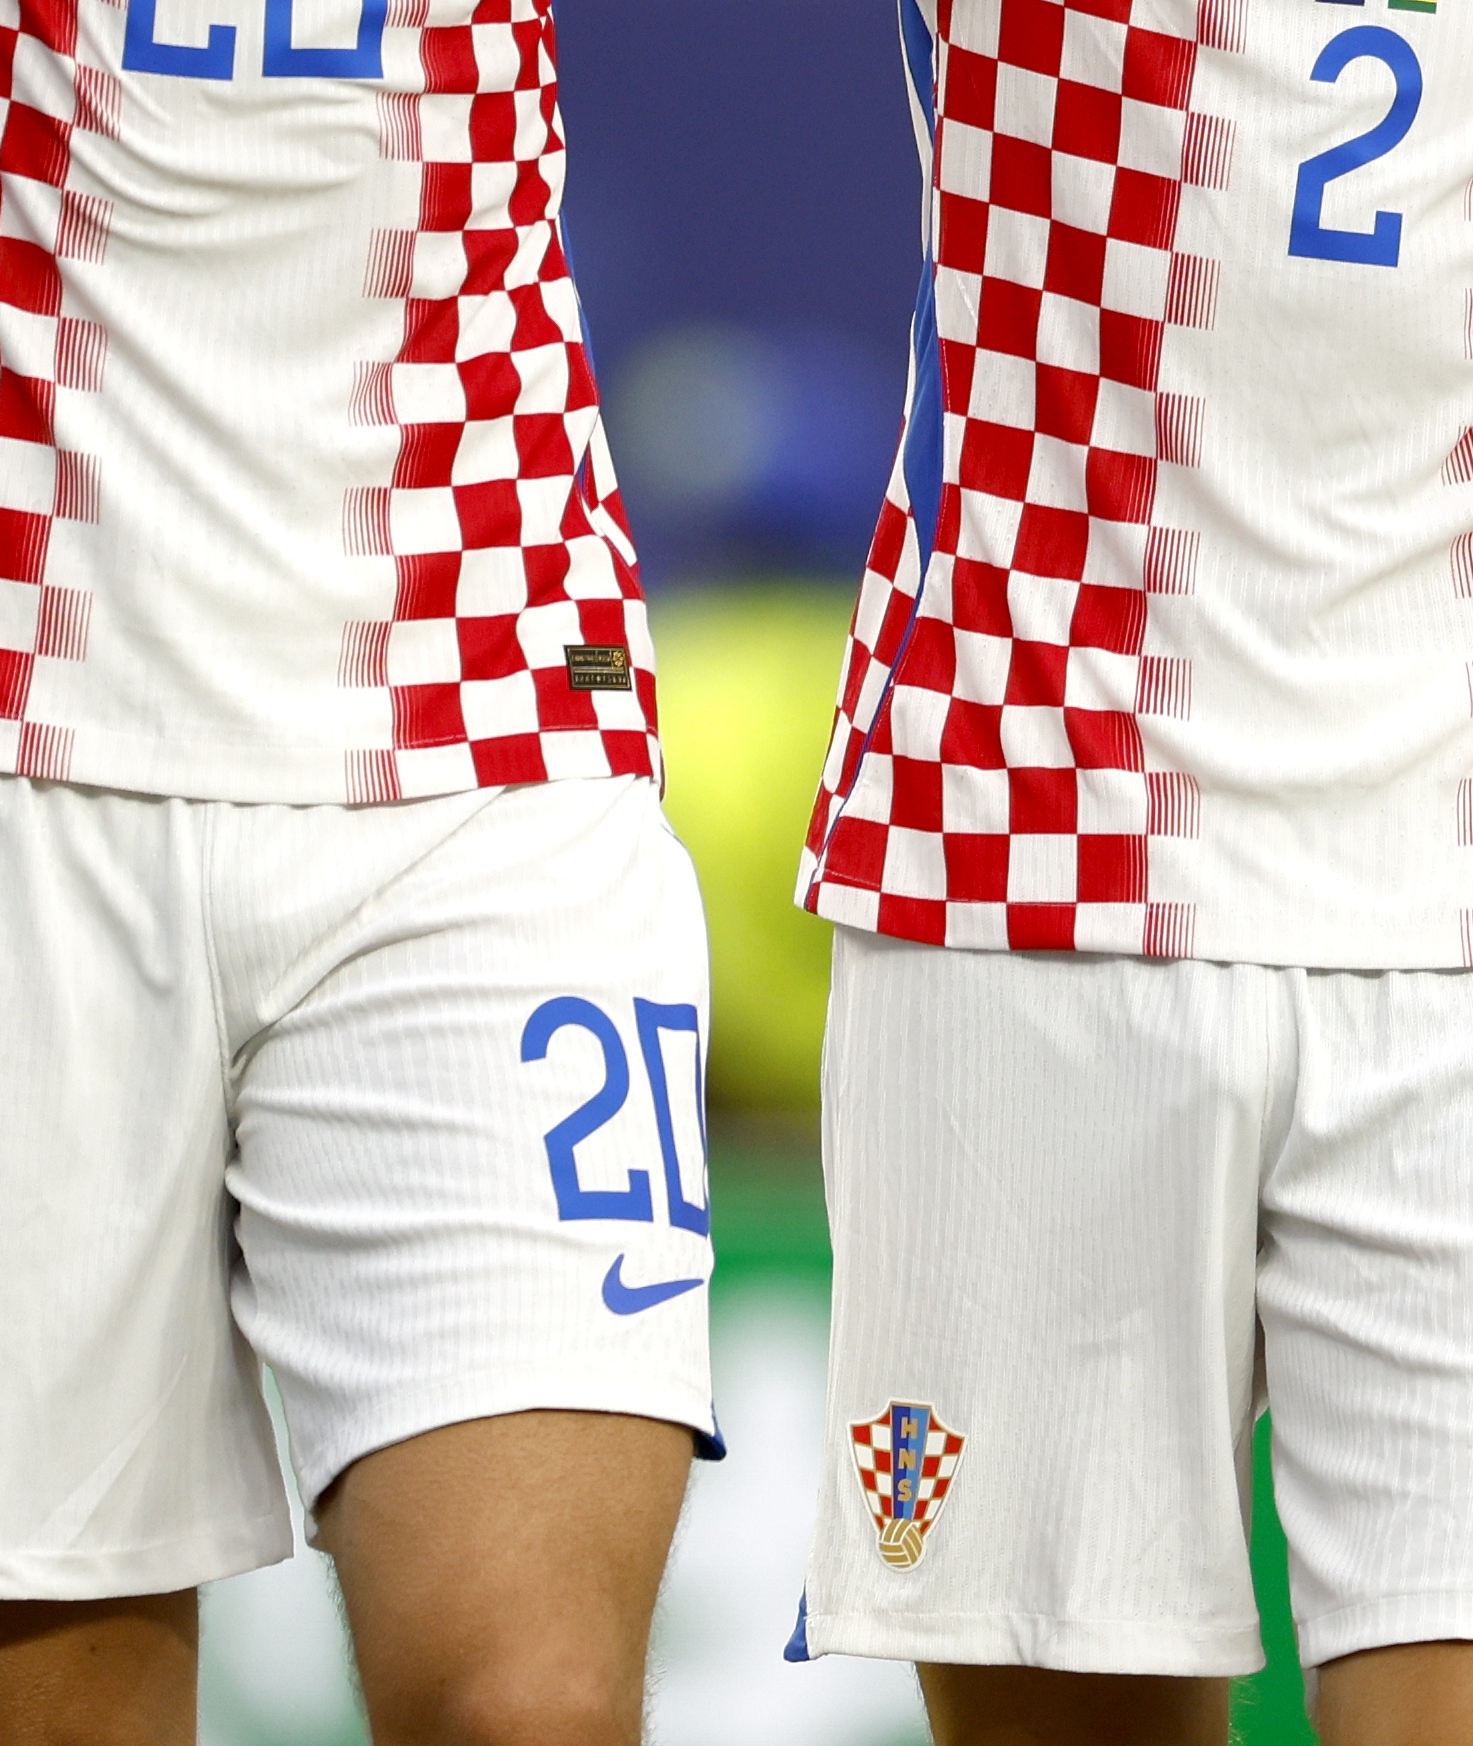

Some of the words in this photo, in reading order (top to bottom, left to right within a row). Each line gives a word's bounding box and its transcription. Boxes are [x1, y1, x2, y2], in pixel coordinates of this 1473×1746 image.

[1288, 24, 1424, 268] 2
[521, 995, 710, 1238] 20
[897, 1416, 918, 1502] HNS
